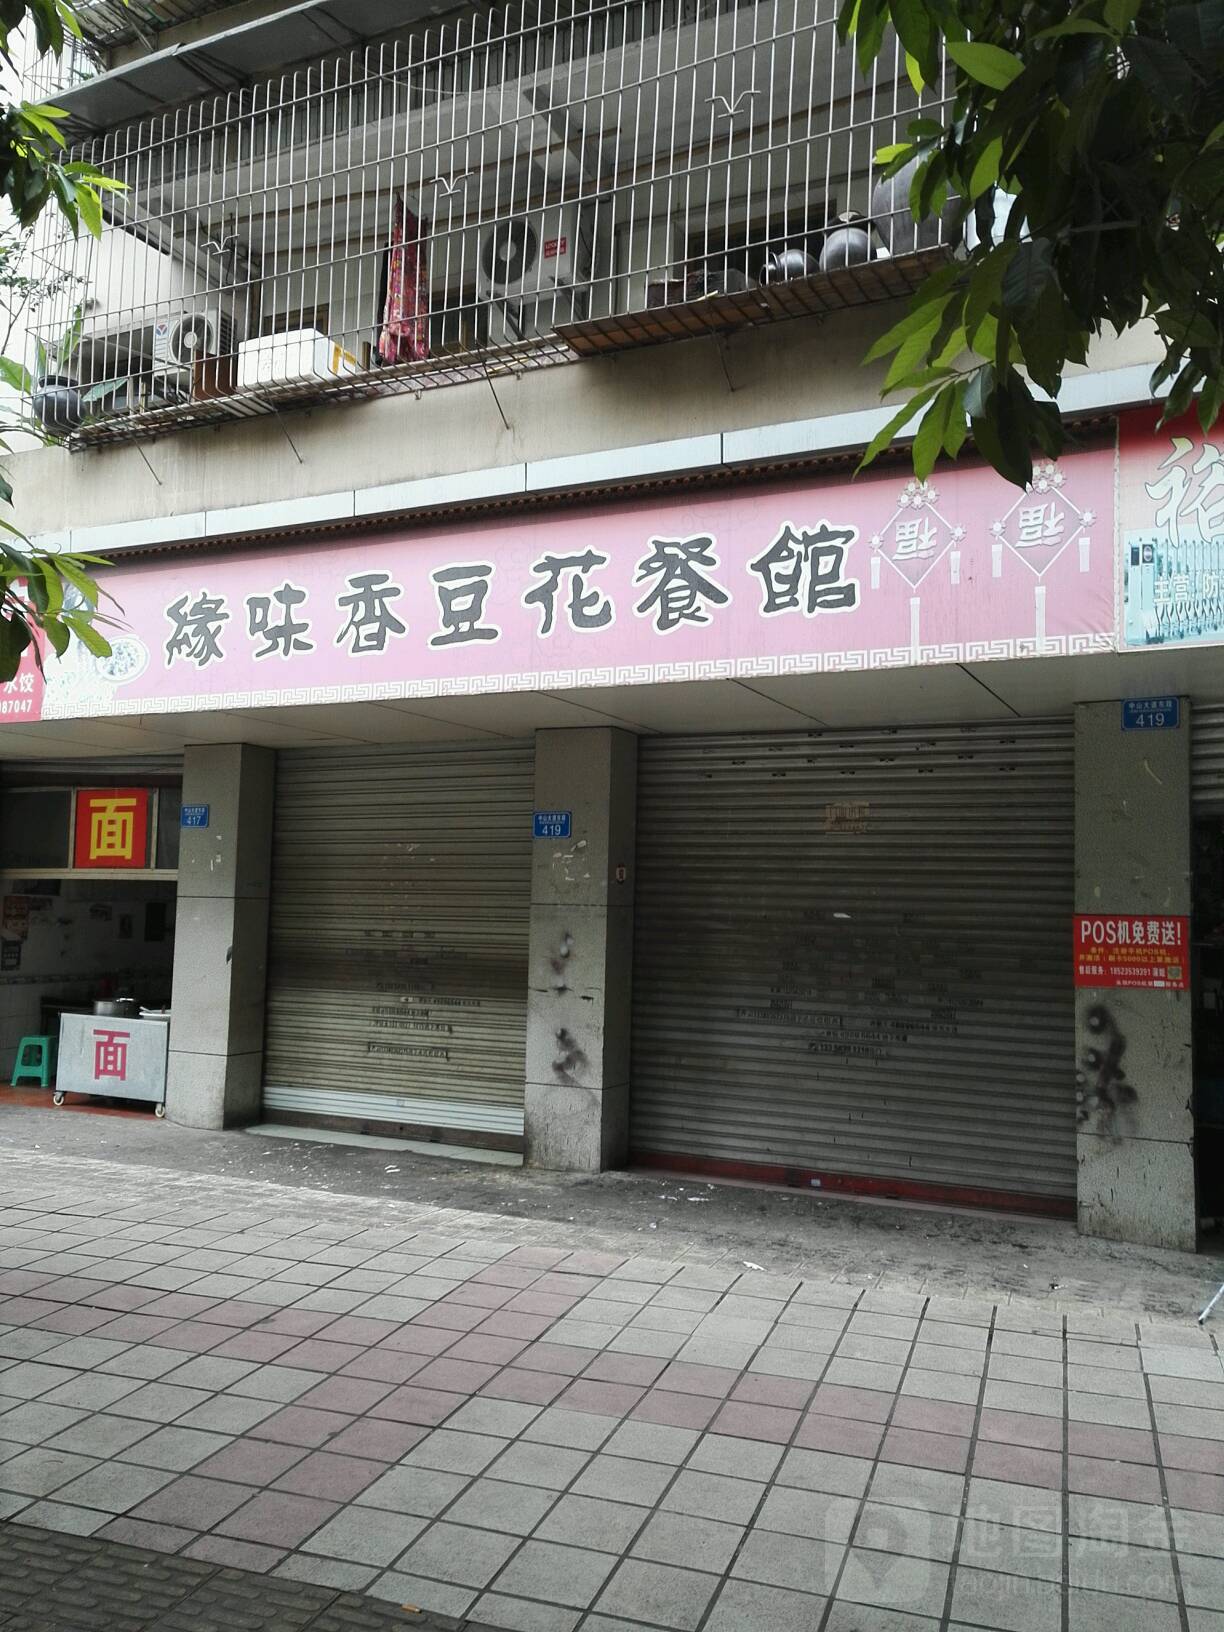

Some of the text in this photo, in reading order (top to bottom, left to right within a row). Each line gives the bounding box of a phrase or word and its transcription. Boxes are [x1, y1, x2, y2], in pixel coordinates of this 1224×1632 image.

[1136, 712, 1165, 727] 419
[187, 815, 202, 825] 417
[89, 797, 137, 860] 面
[541, 824, 562, 836] 419
[93, 1028, 131, 1081] 面
